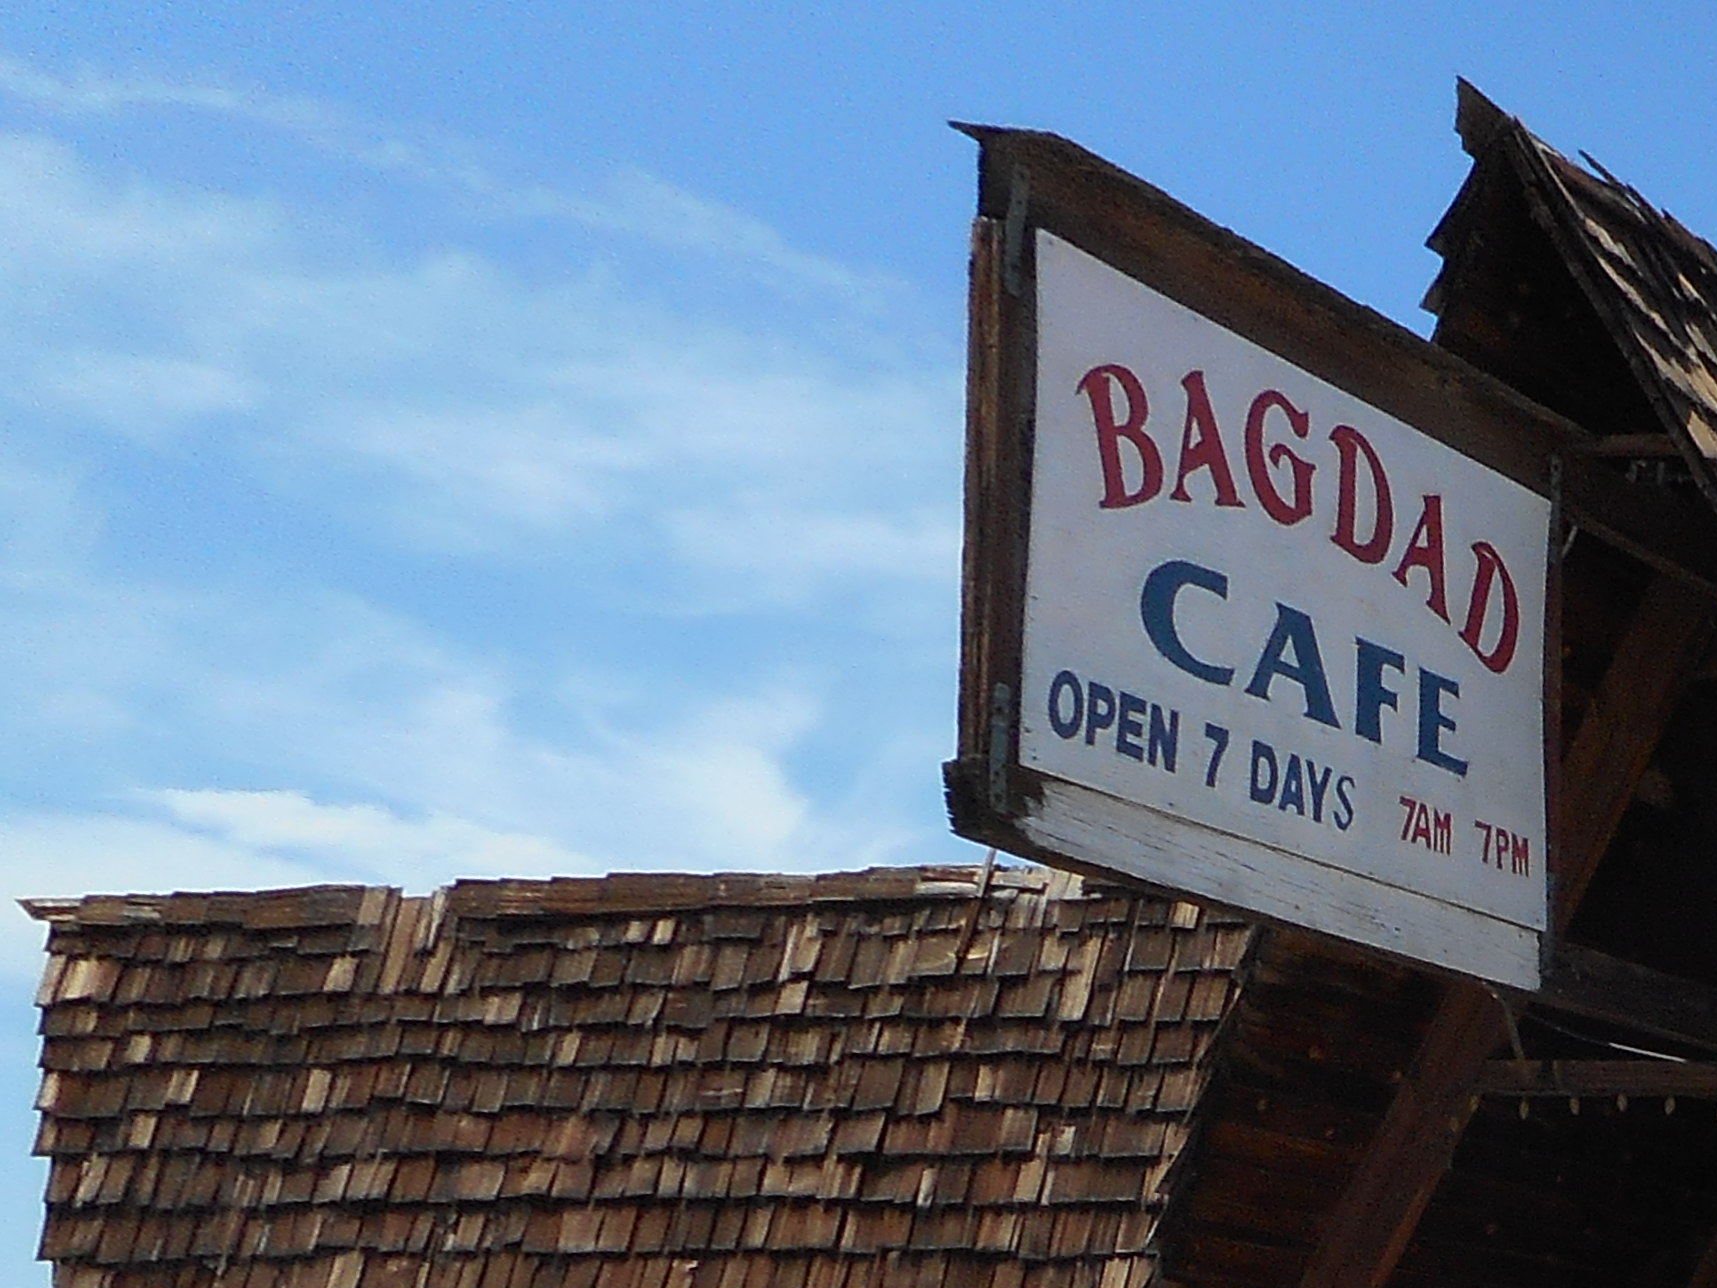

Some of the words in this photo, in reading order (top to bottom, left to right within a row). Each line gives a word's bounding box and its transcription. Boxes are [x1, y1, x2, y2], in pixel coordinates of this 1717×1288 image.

[1076, 363, 1520, 674] BAGDAD
[1048, 669, 1179, 773] OPEN
[1203, 722, 1230, 789] 7
[1250, 740, 1355, 832] DAYS
[1399, 796, 1452, 857] 7AM
[1475, 819, 1529, 877] 7PM
[1140, 559, 1468, 777] CAFE
